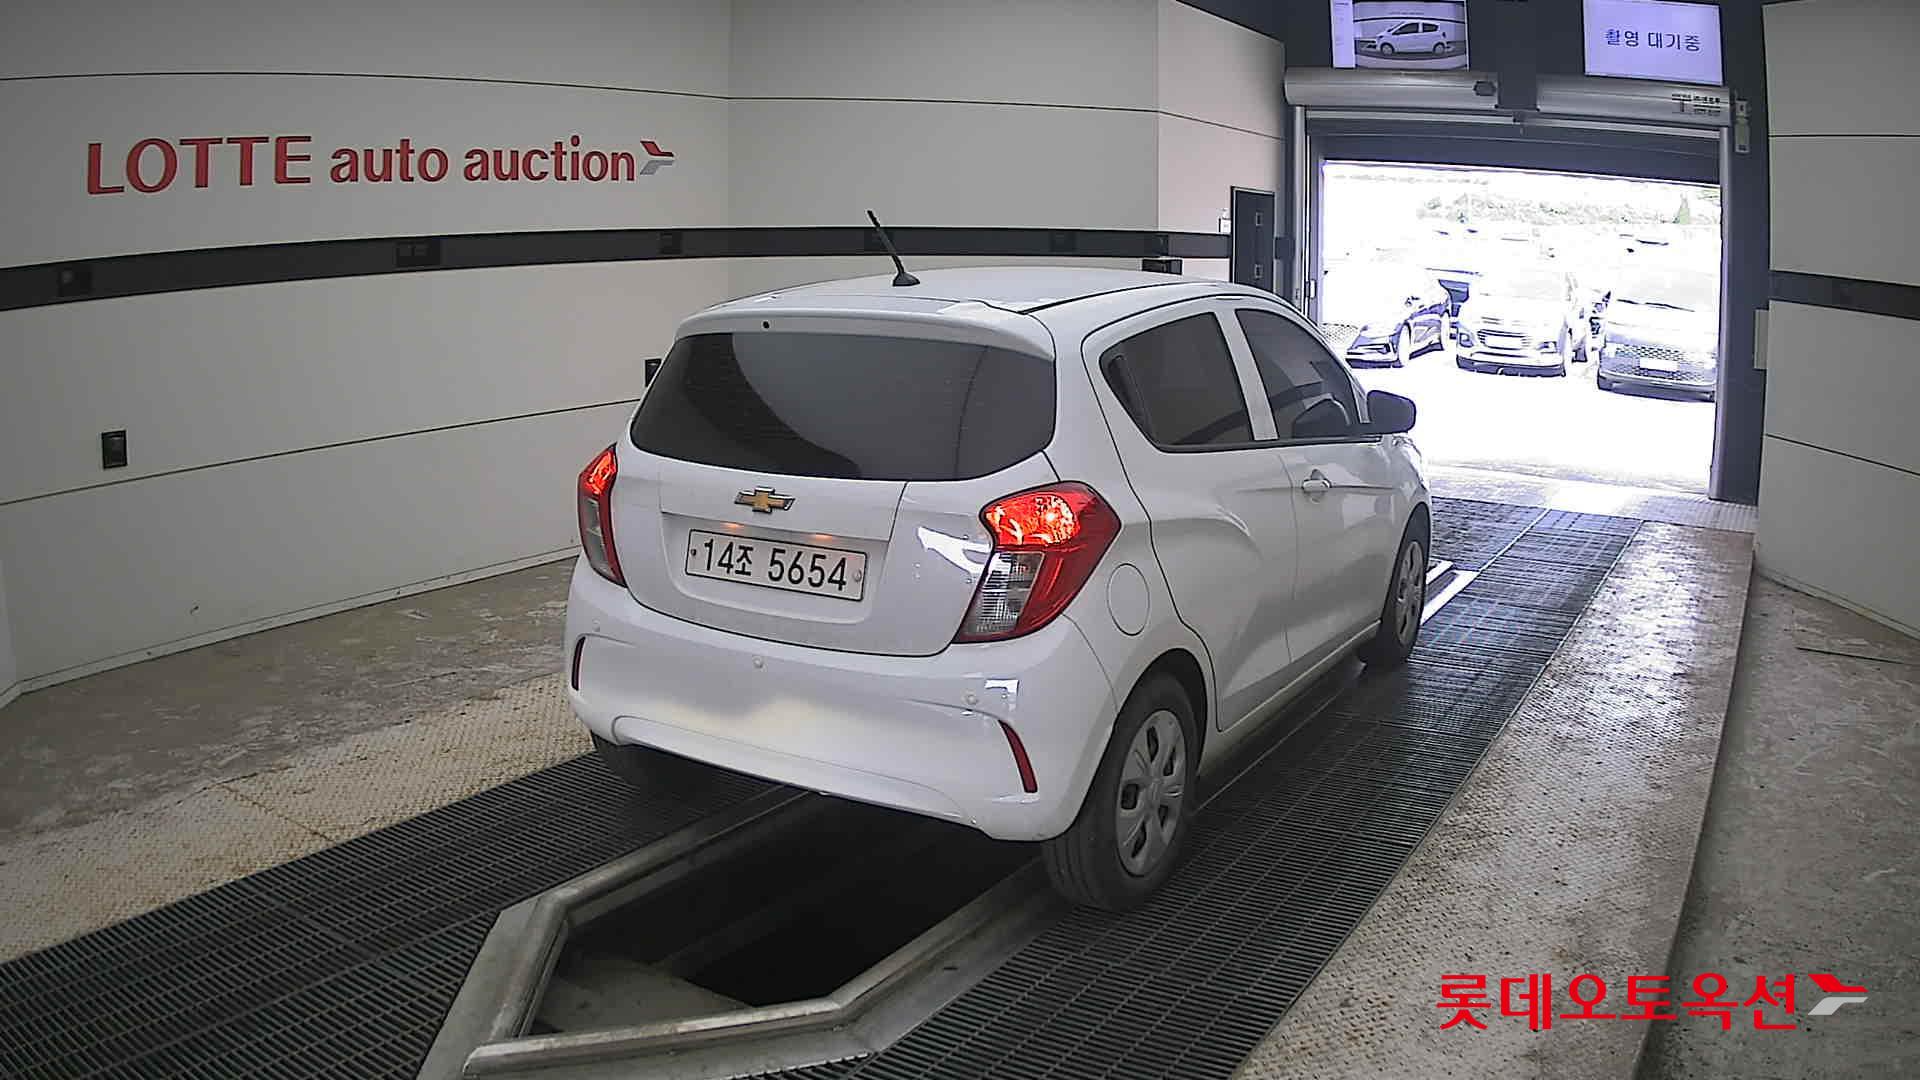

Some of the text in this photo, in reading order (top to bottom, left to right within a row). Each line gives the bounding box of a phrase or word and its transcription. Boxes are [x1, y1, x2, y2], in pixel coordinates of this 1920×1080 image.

[1647, 32, 1701, 51] 대기중
[86, 135, 636, 195] LOTTE auto auction
[704, 538, 847, 591] 14조 5654
